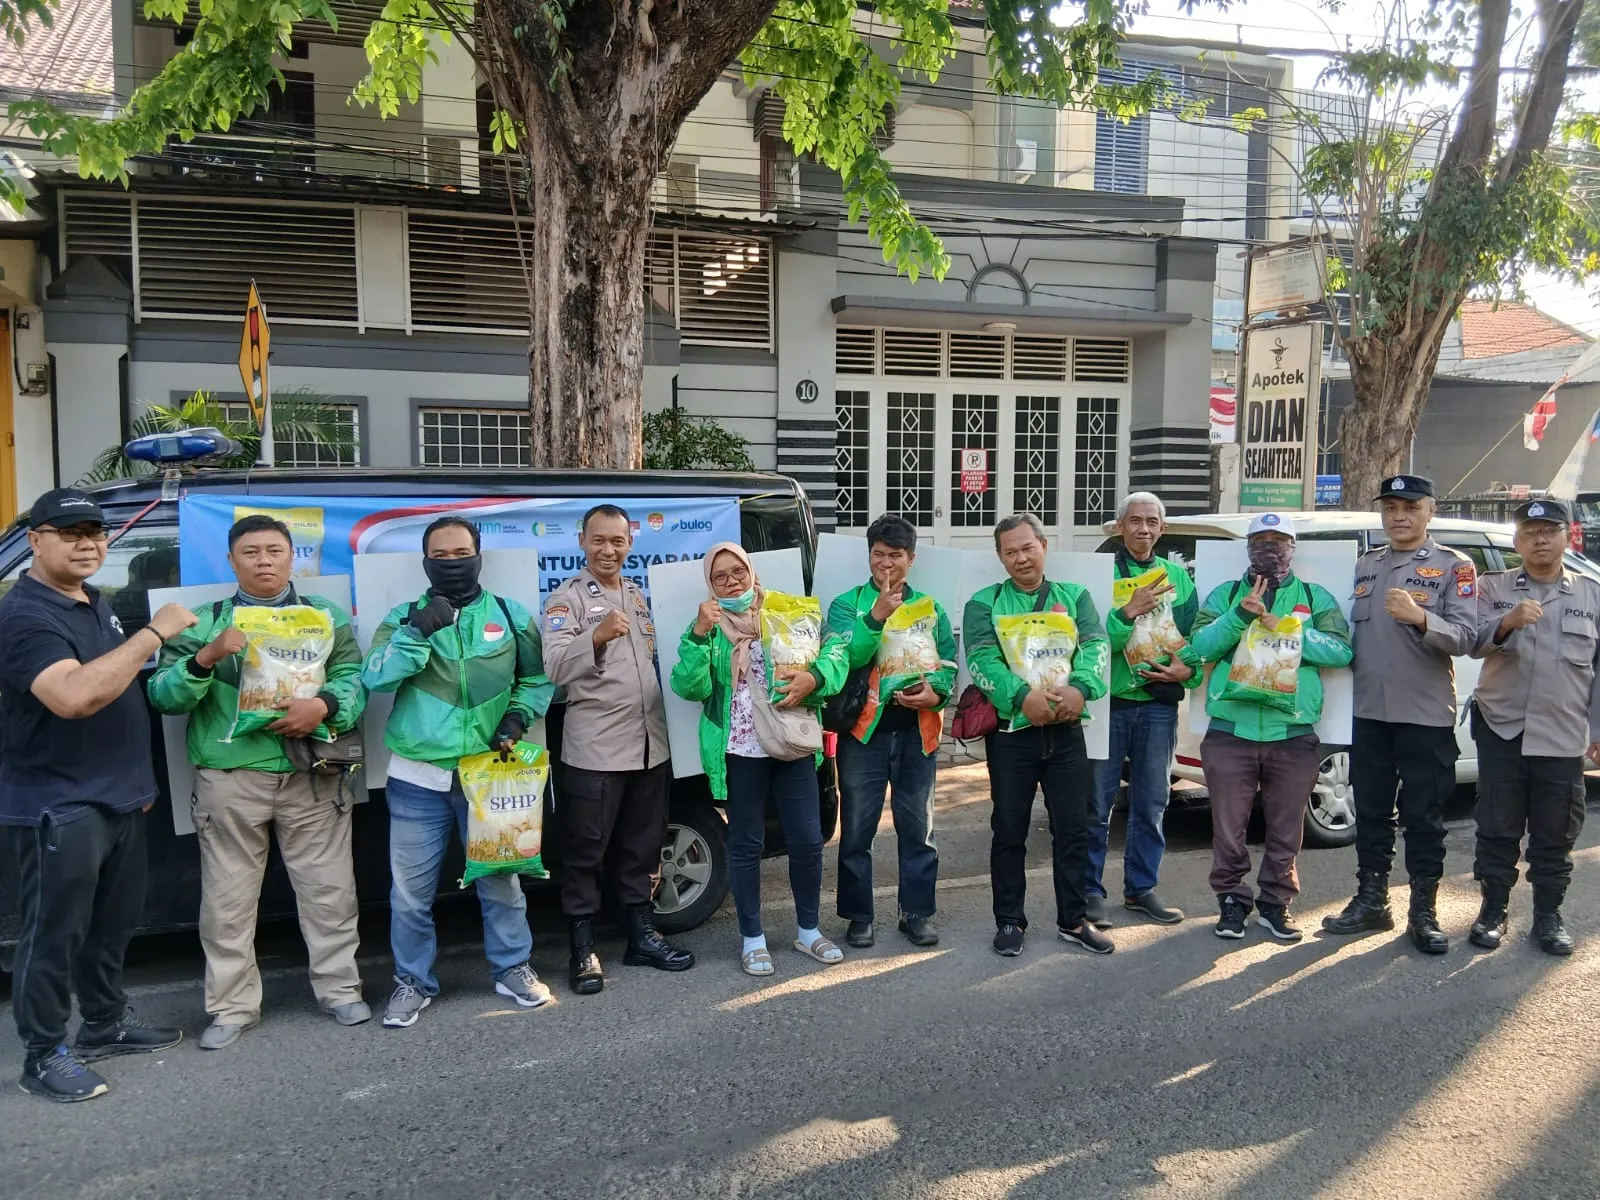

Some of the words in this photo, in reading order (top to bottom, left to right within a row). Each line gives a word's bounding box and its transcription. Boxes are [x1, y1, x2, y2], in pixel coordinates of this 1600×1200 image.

[1252, 369, 1304, 390] Apotek
[800, 382, 817, 400] 10
[1247, 397, 1305, 443] DIAN
[1245, 448, 1302, 480] SEJAHTERA
[680, 519, 713, 532] bulog
[538, 556, 586, 571] NTUK
[1405, 578, 1440, 590] POLRI
[1565, 608, 1594, 621] POLRI
[268, 646, 318, 661] SPHP
[1028, 647, 1069, 659] SPHP
[490, 794, 537, 811] SPHP
